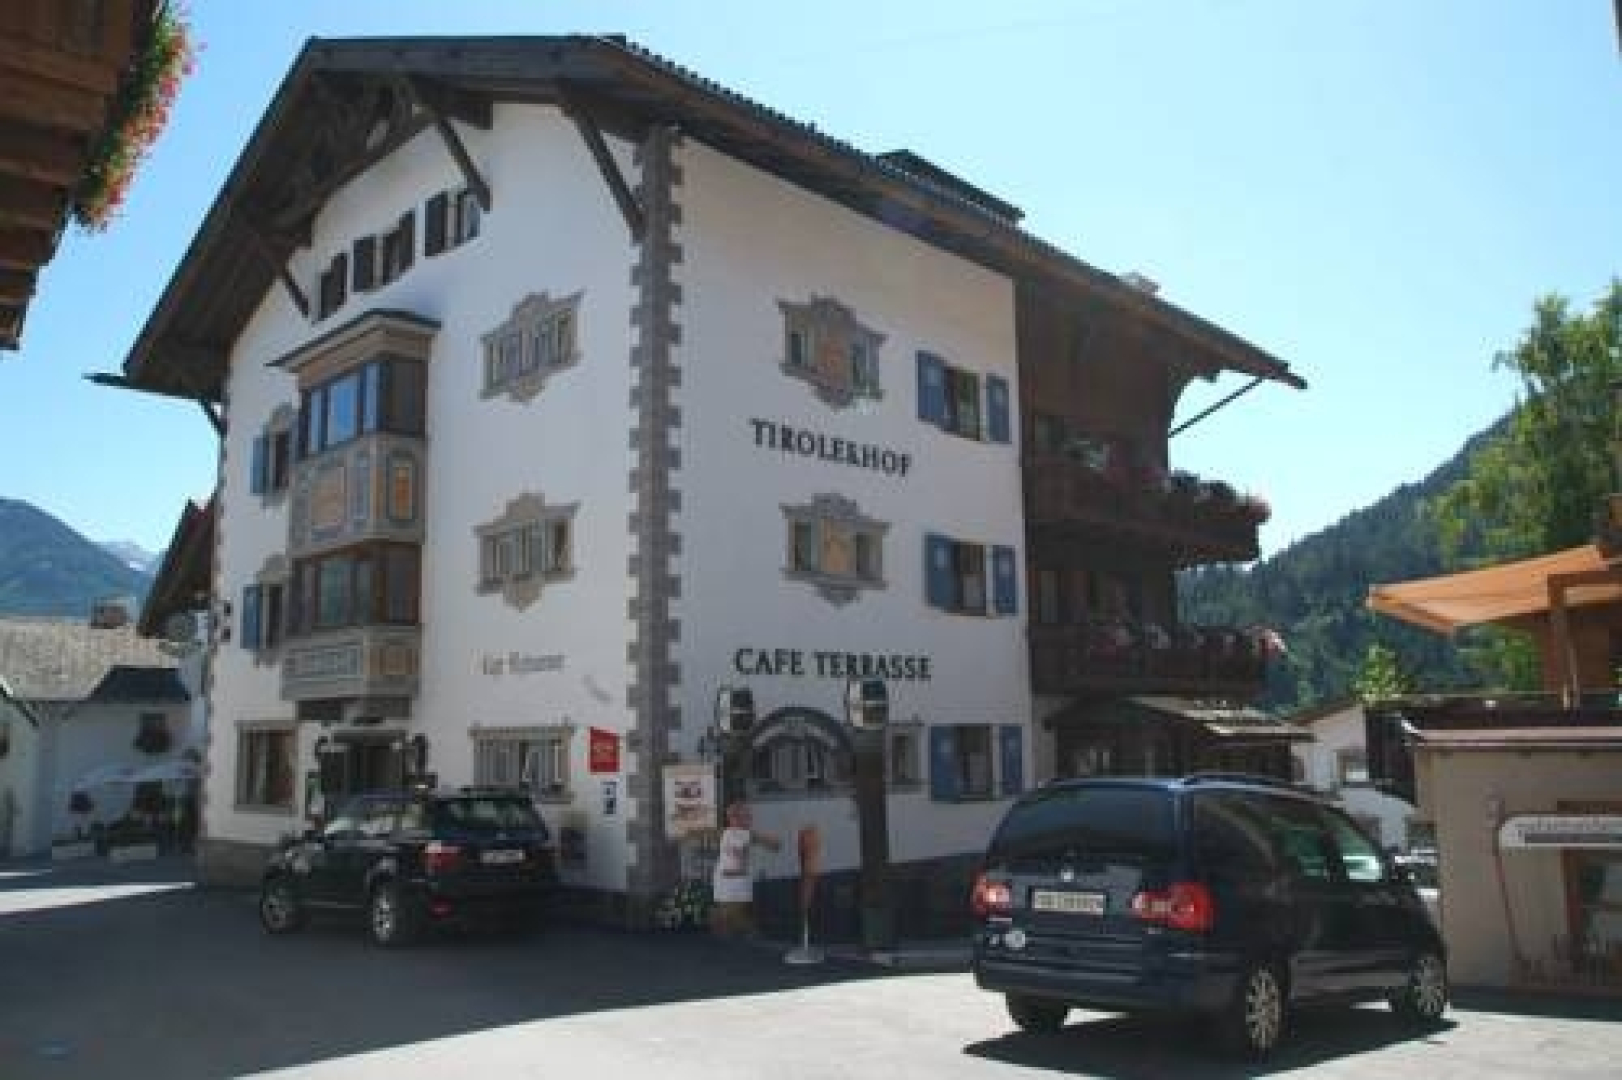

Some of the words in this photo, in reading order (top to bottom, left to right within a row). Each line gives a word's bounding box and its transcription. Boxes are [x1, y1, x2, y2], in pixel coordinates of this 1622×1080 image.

[749, 417, 912, 477] TIROLERHOF
[735, 648, 804, 675] CAFE
[814, 650, 932, 681] TERRASSE
